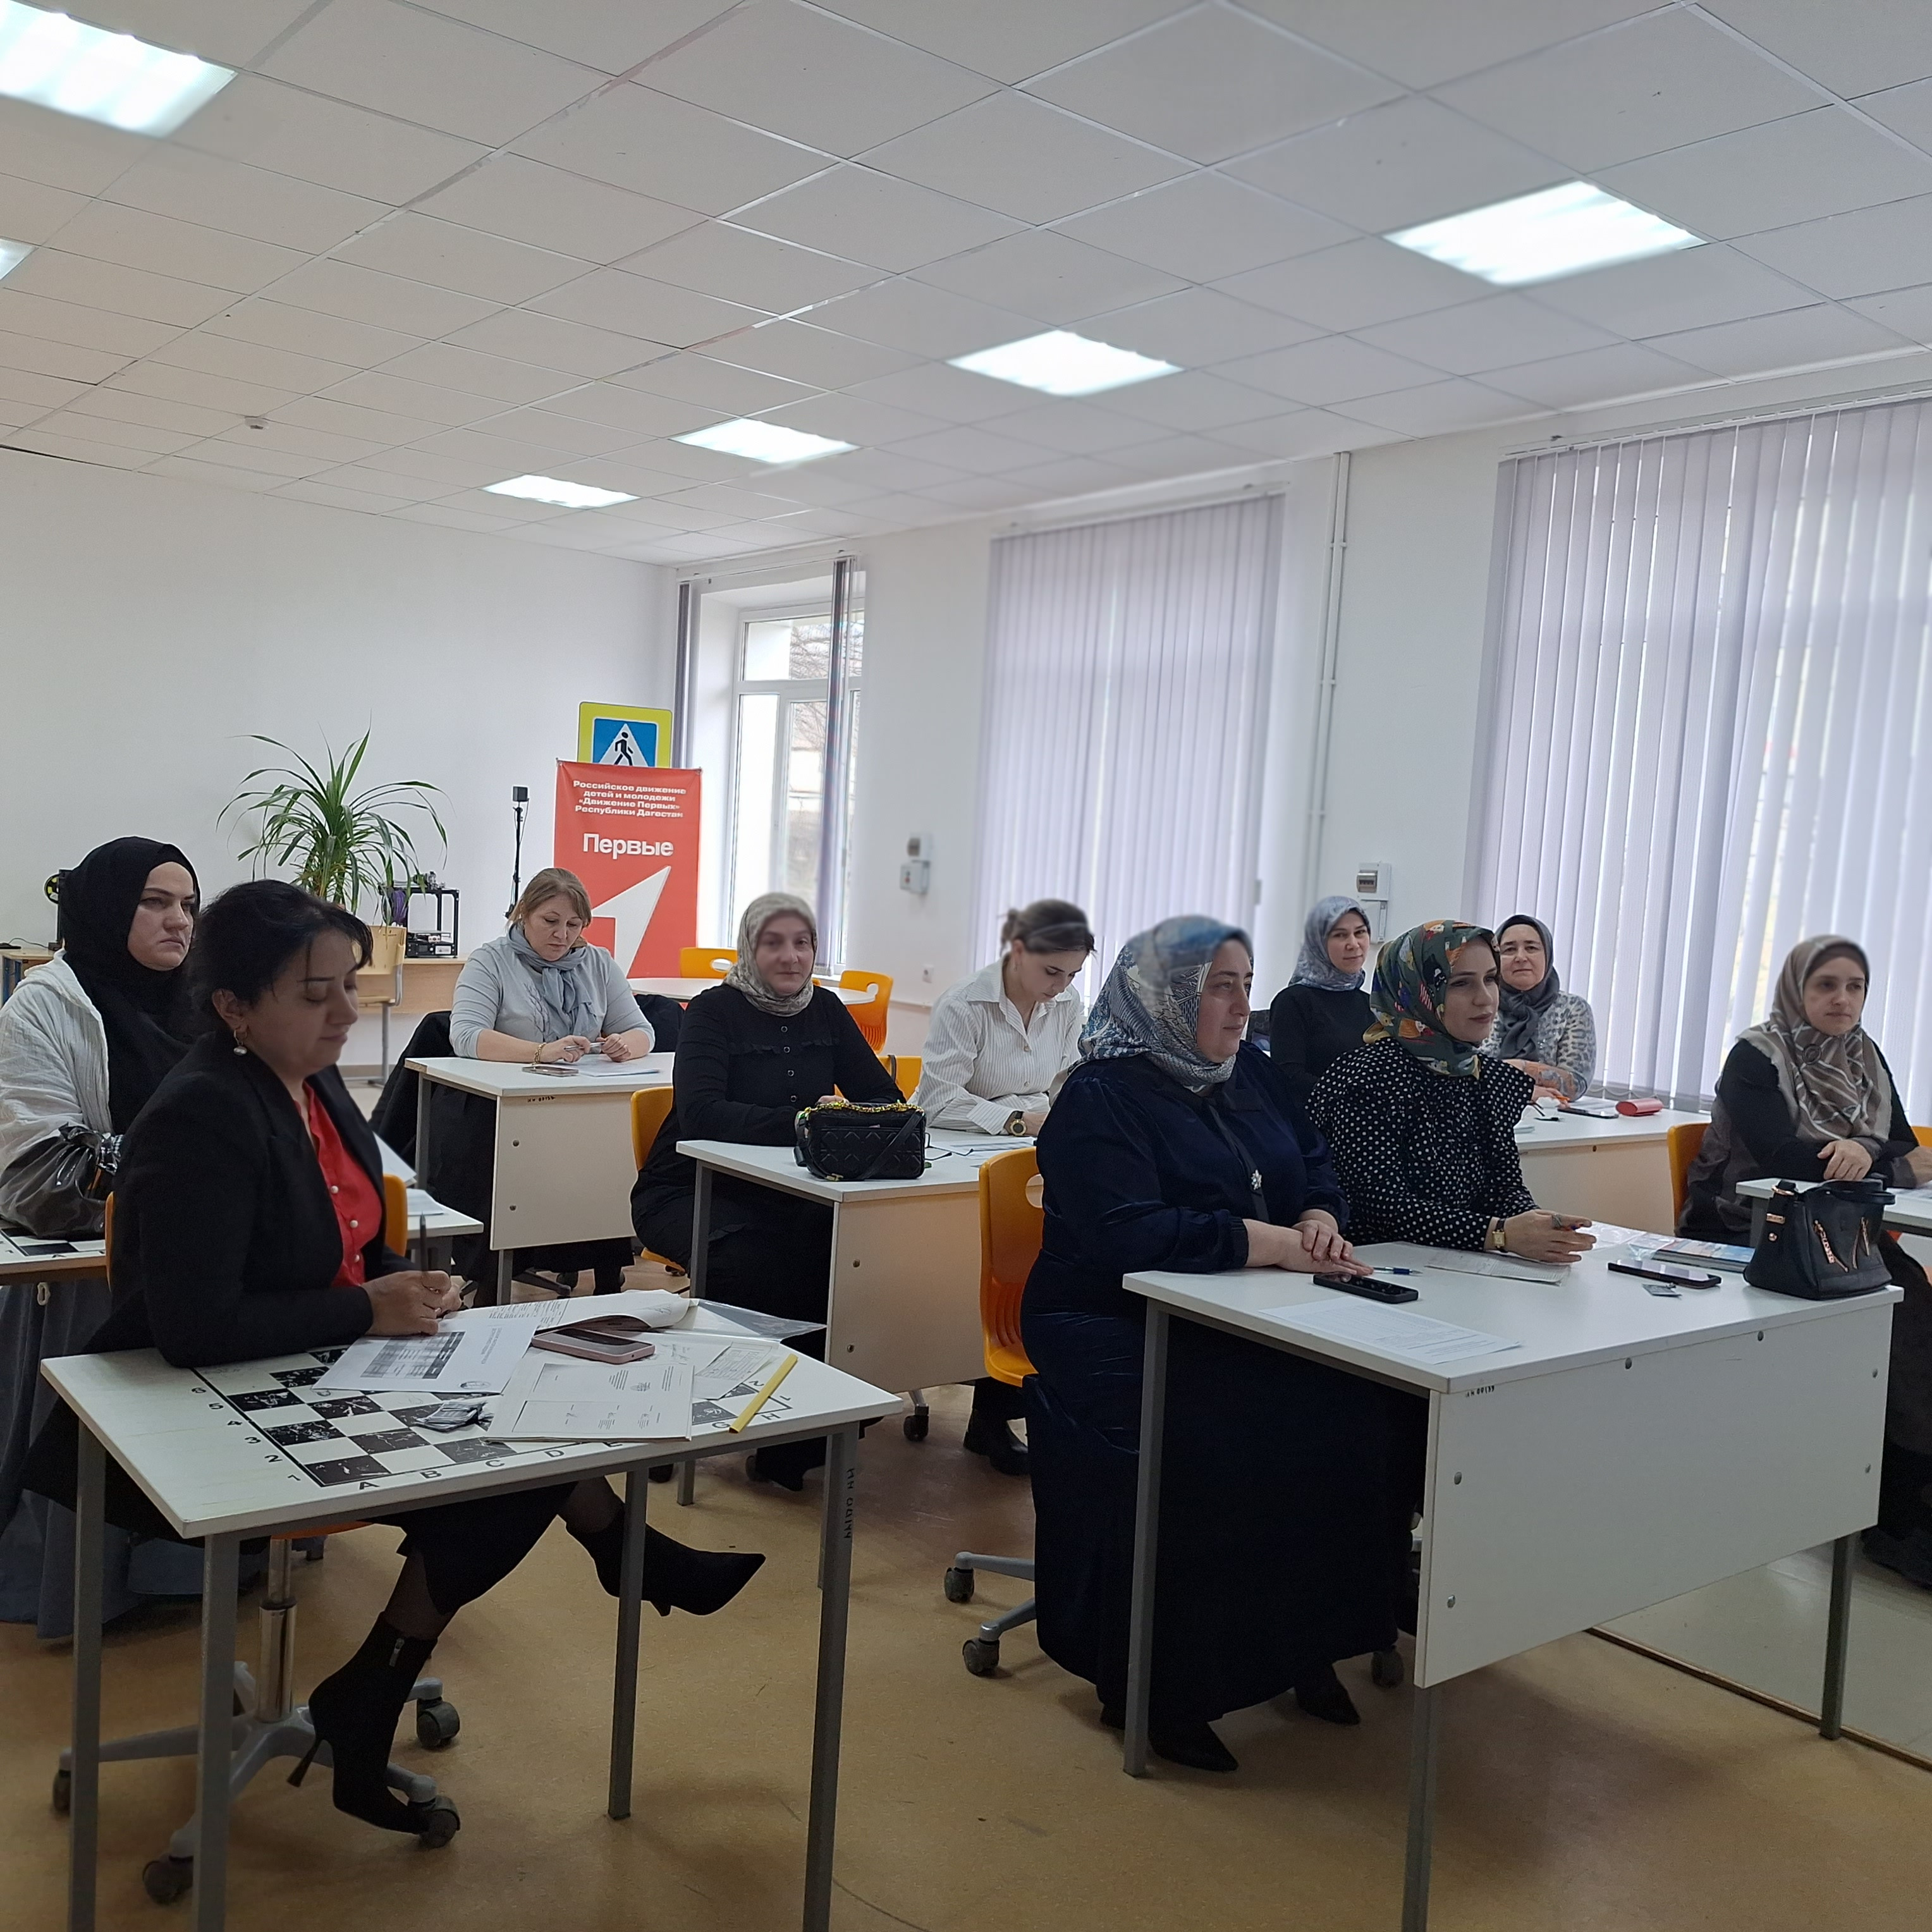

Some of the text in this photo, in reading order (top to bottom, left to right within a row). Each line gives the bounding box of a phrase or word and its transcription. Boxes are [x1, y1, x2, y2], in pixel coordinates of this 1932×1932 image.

[573, 780, 687, 795] Российское движение
[575, 805, 683, 817] Республики Дагестан
[579, 798, 680, 810] «Движение Первых»
[583, 833, 674, 860] Первые
[359, 1481, 381, 1490] A
[420, 1470, 442, 1479] B
[485, 1459, 505, 1467] C
[544, 1450, 565, 1458] D
